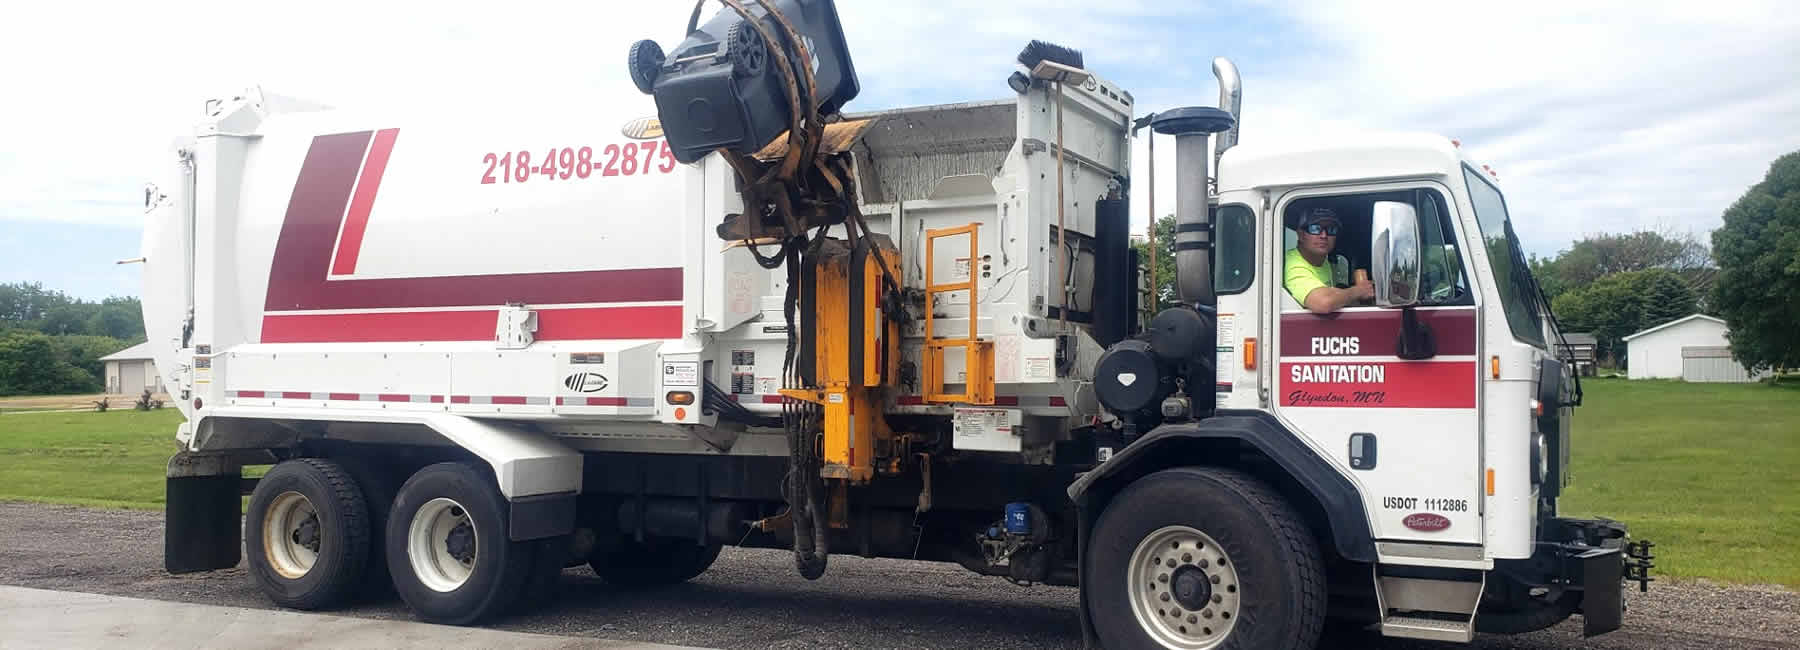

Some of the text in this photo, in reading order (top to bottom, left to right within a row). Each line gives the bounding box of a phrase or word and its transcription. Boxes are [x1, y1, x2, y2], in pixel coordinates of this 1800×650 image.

[481, 140, 676, 184] 218-498-2875
[1311, 336, 1360, 354] FUCHS
[1291, 364, 1385, 383] SANITATION
[1352, 390, 1386, 403] MN
[1383, 496, 1468, 512] USDOT 1112886
